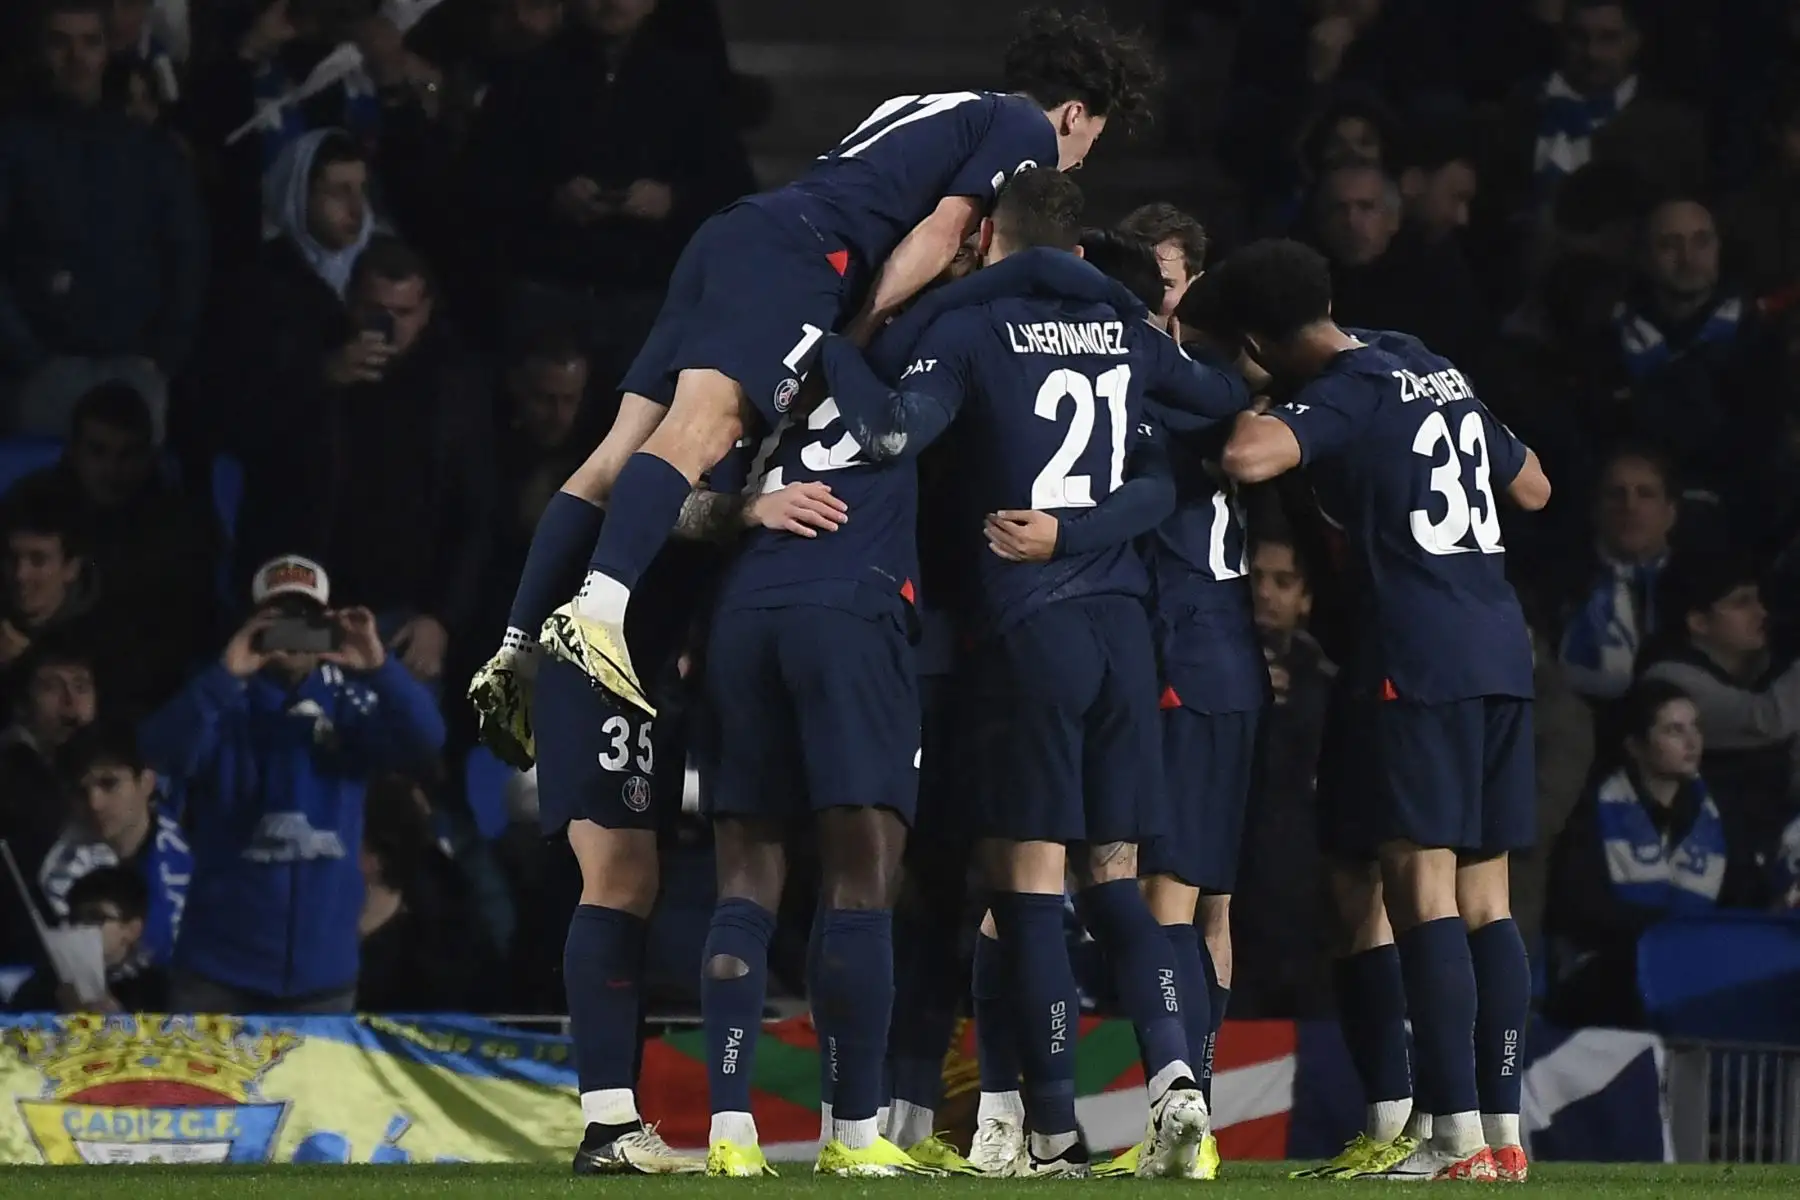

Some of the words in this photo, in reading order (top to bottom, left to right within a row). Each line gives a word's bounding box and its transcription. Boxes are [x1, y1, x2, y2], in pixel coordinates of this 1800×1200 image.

[783, 323, 823, 382] 1
[1031, 364, 1131, 510] 21
[1410, 411, 1505, 555] 33
[599, 716, 654, 775] 35
[1158, 968, 1178, 1012] PARIS
[723, 1027, 744, 1075] PARIS
[1051, 1000, 1066, 1054] PARIS
[1501, 1029, 1518, 1076] PARIS
[1203, 1031, 1216, 1079] PARIS
